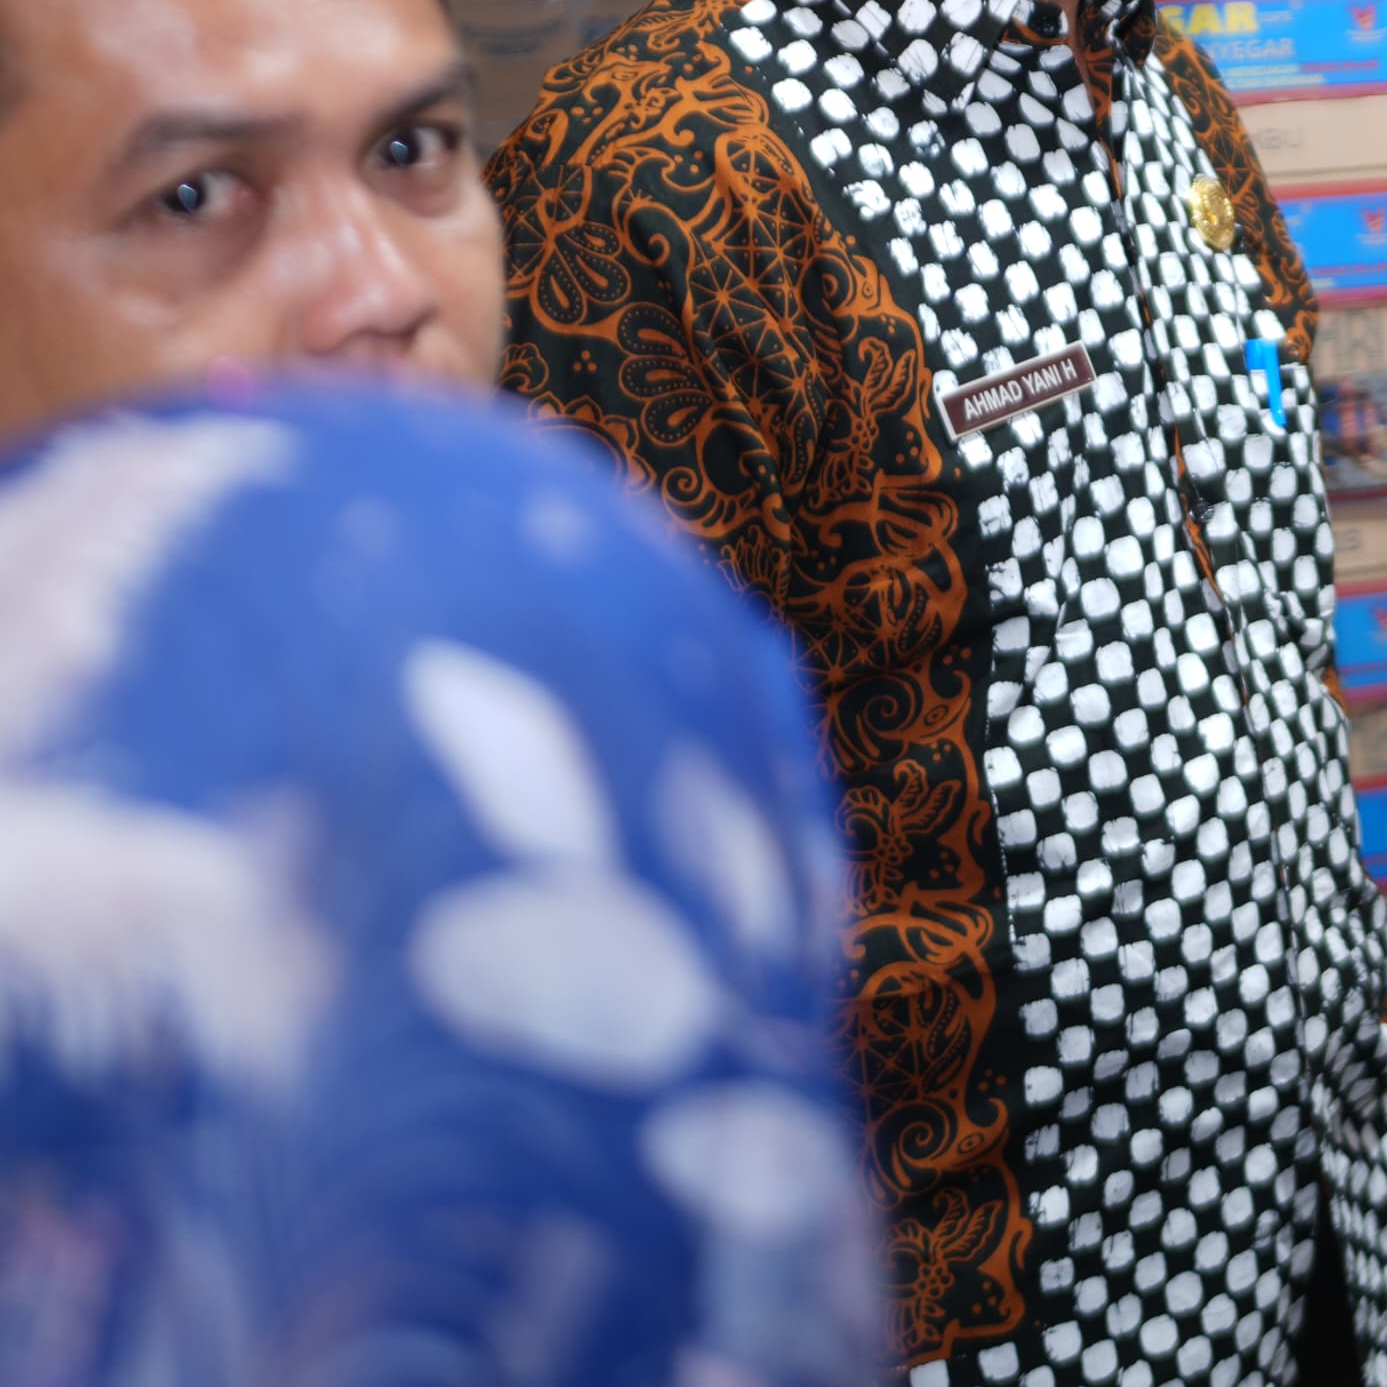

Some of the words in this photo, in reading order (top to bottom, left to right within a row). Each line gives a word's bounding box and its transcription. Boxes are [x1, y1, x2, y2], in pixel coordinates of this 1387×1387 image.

[963, 379, 1024, 422] AHMAD
[1023, 365, 1066, 398] YANI
[1063, 357, 1078, 382] H
